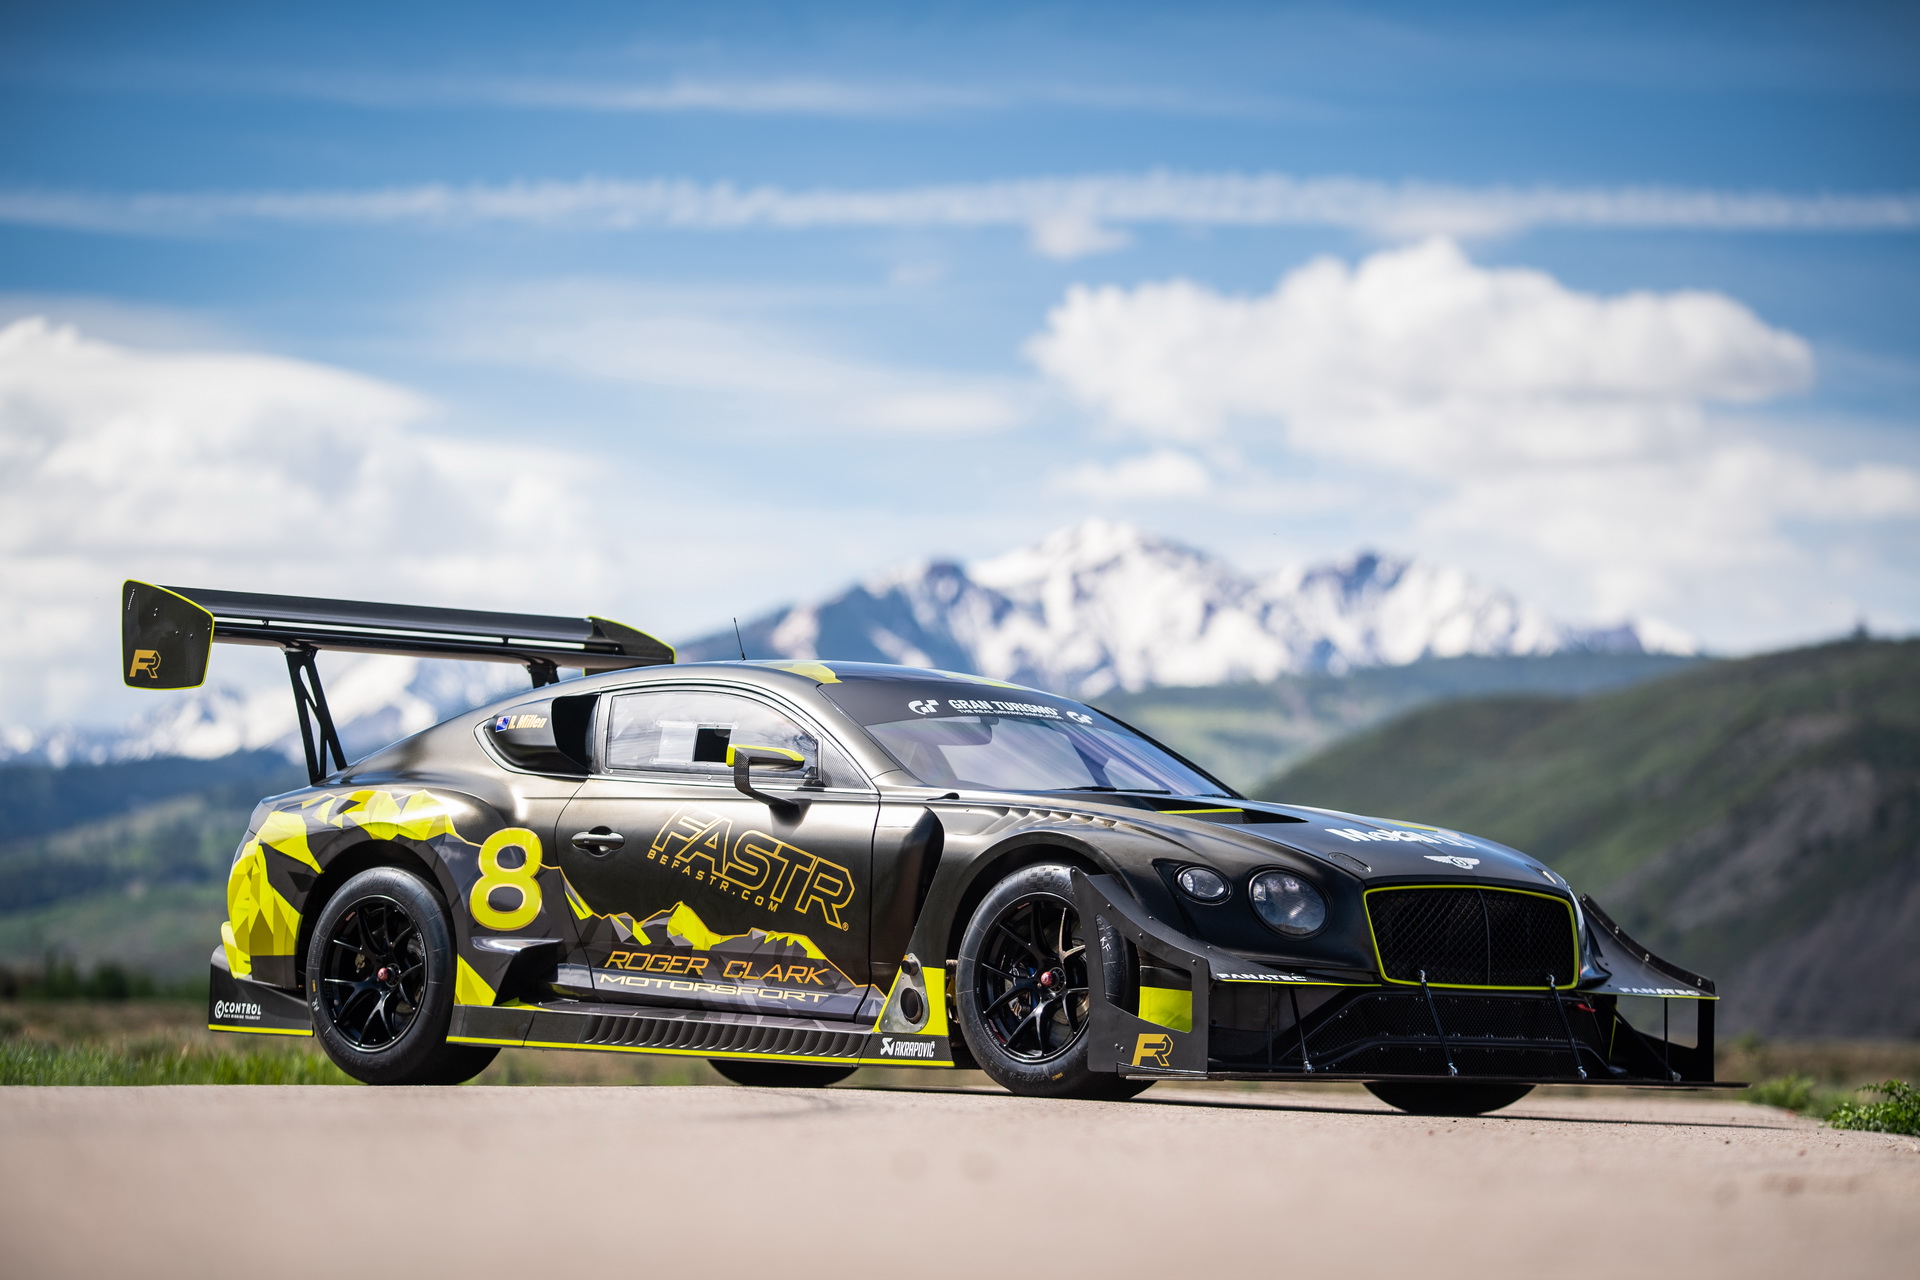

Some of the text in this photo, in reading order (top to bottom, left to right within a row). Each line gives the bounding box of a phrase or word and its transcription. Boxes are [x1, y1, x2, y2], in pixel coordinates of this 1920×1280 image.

[948, 699, 994, 710] GRAN
[516, 714, 548, 729] Millen
[469, 827, 543, 931] 8
[646, 848, 780, 913] BEFASTR.COM
[603, 950, 830, 986] ROGER CLARK
[1216, 973, 1307, 982] FANATEC
[599, 974, 829, 1003] MOTORSPORT
[224, 1002, 262, 1015] CONTROL
